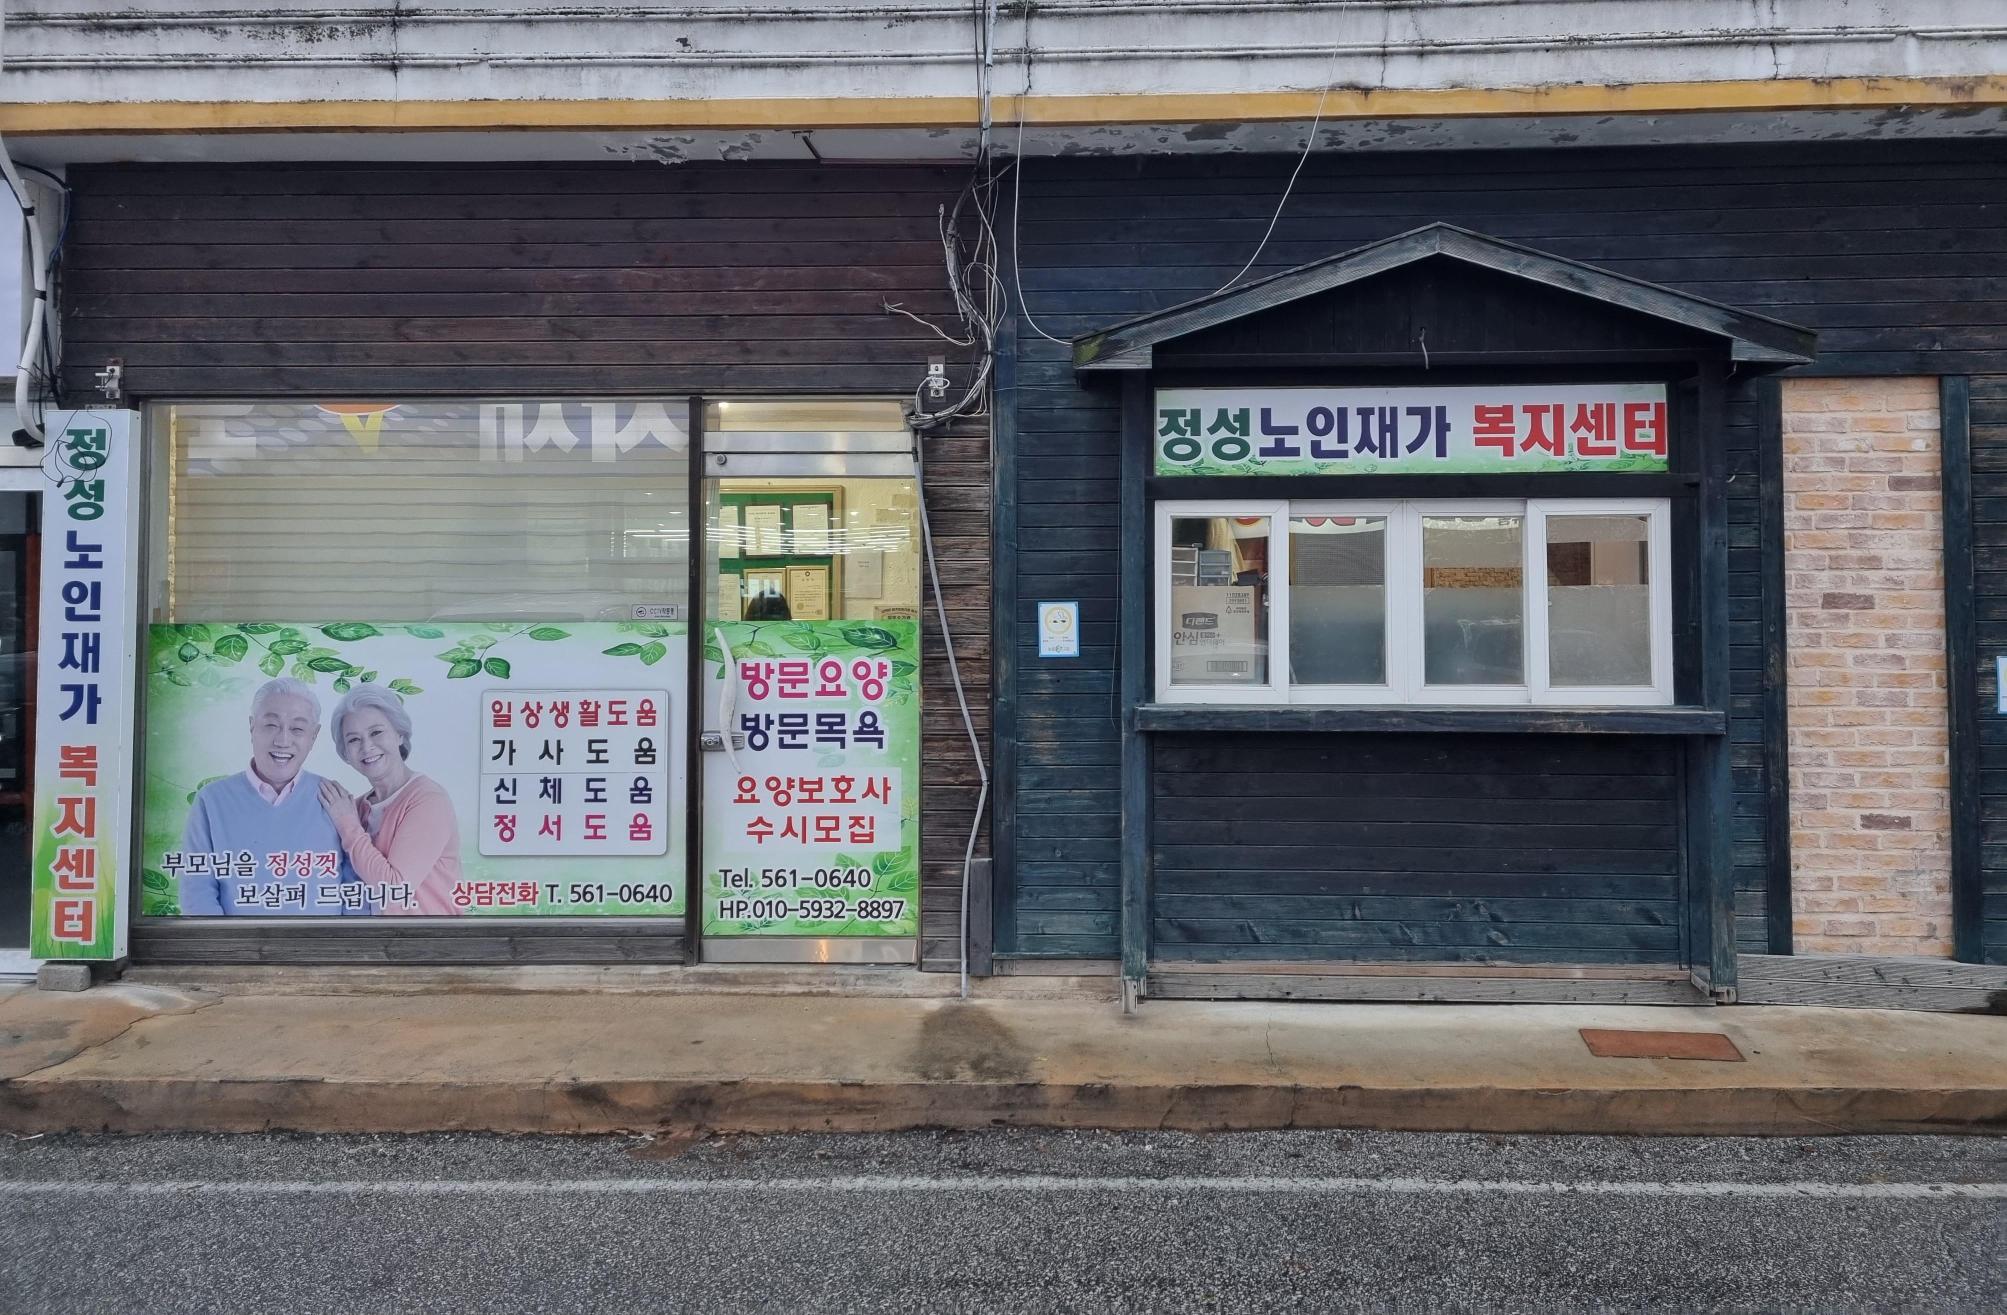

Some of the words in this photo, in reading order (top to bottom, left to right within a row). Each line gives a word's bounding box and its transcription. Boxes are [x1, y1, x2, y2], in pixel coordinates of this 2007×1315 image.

[1158, 404, 1451, 461] 정성노인재가
[1473, 402, 1667, 458] 복지센터
[58, 428, 107, 725] 정성노인재가
[741, 660, 888, 700] 방문요양
[491, 698, 657, 728] 일상생활도움
[741, 710, 885, 751] 방문목욕
[733, 775, 892, 807] 요양보호사
[53, 745, 98, 942] 복지센터
[746, 816, 875, 844] 수시모집
[161, 852, 257, 877] 부모님을
[267, 852, 337, 877] 정성껏
[719, 868, 753, 888] Tel.
[761, 868, 871, 888] 561-0640
[236, 883, 306, 908] 보살펴
[317, 883, 418, 908] 드립니다.
[452, 881, 539, 906] 상담전화
[545, 884, 562, 903] T.
[570, 883, 673, 903] 561-0640
